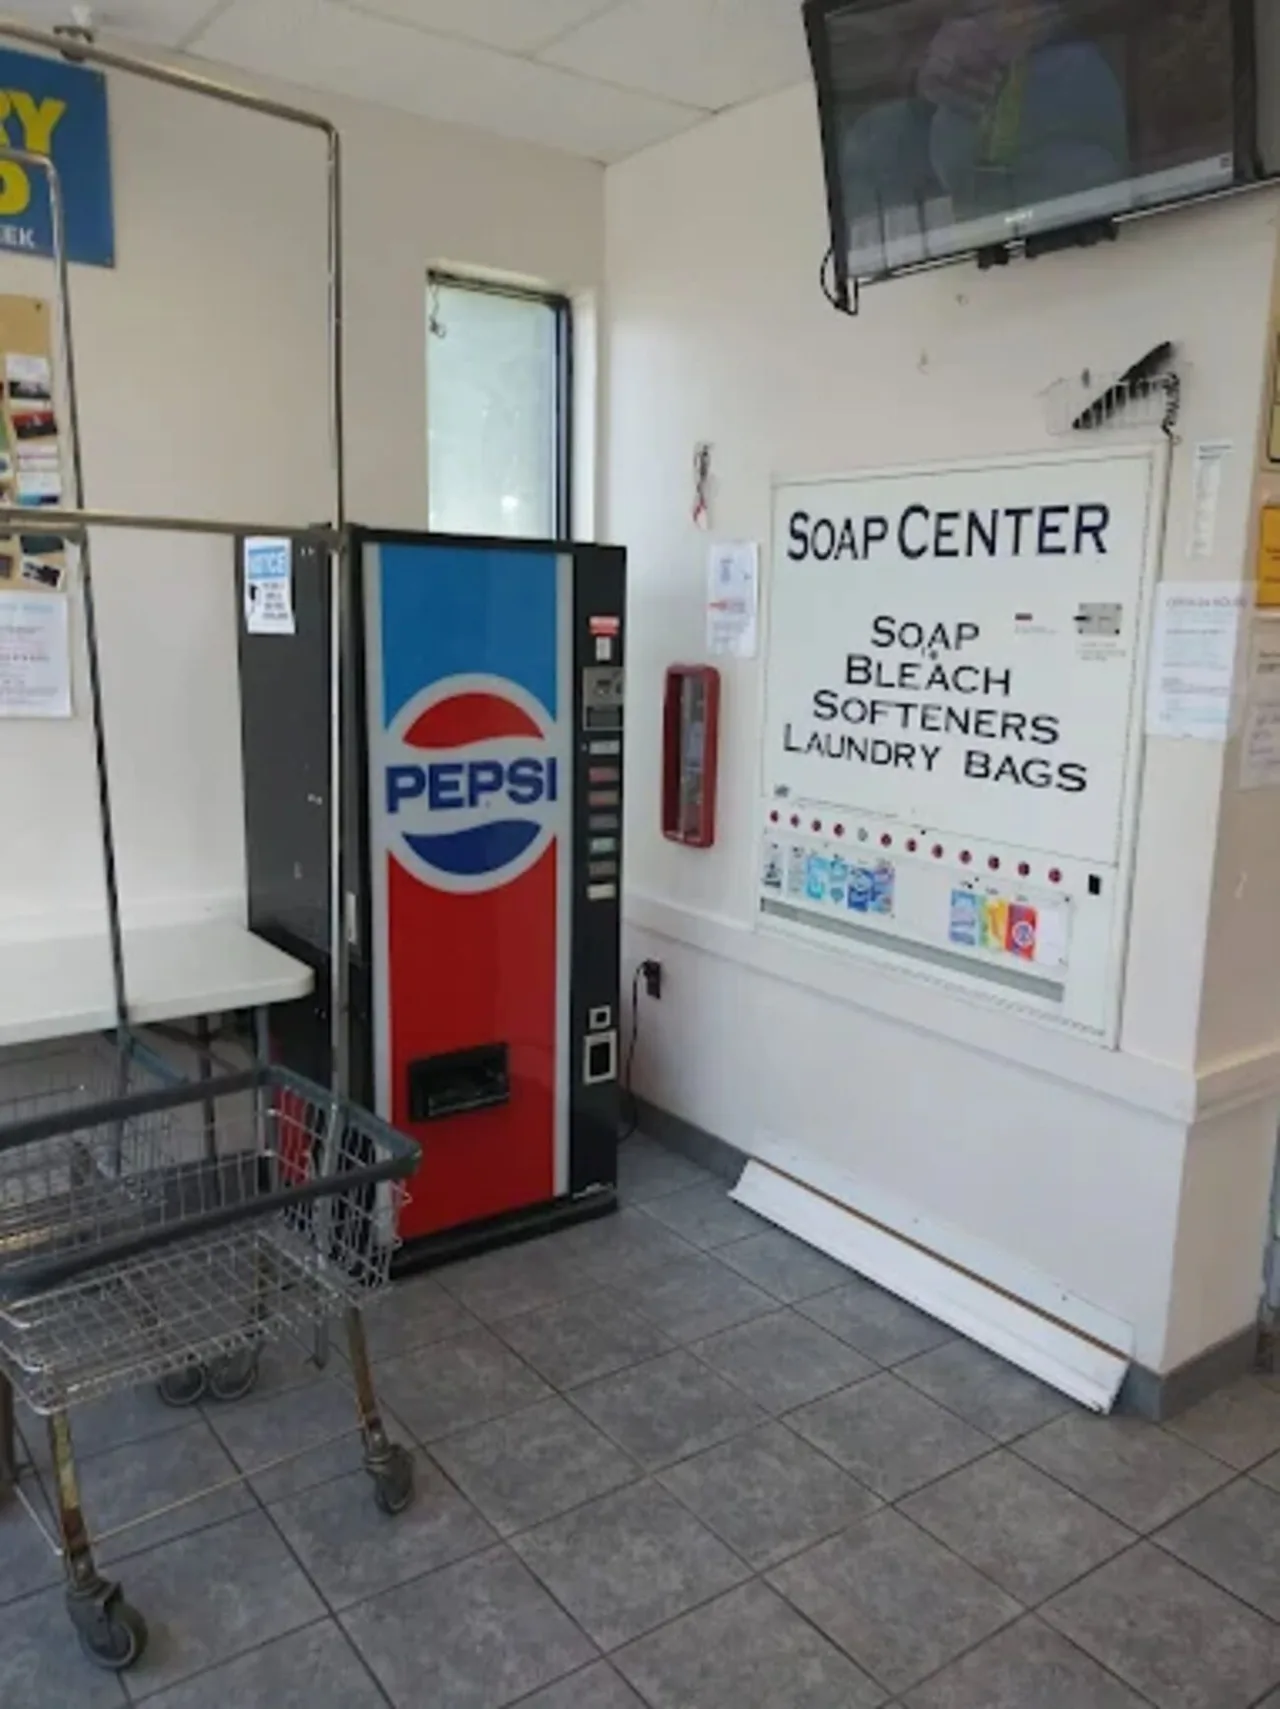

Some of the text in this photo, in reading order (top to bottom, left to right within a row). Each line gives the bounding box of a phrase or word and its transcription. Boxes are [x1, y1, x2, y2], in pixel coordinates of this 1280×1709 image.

[0, 88, 66, 153] Y
[787, 504, 1110, 560] SOAP CENTER
[871, 615, 979, 650] SOAP
[845, 654, 1011, 696] BLEACH
[813, 689, 1060, 745] SOFTENERS
[385, 756, 557, 814] PEPSI
[783, 723, 1088, 793] LAUNDRY BAGS
